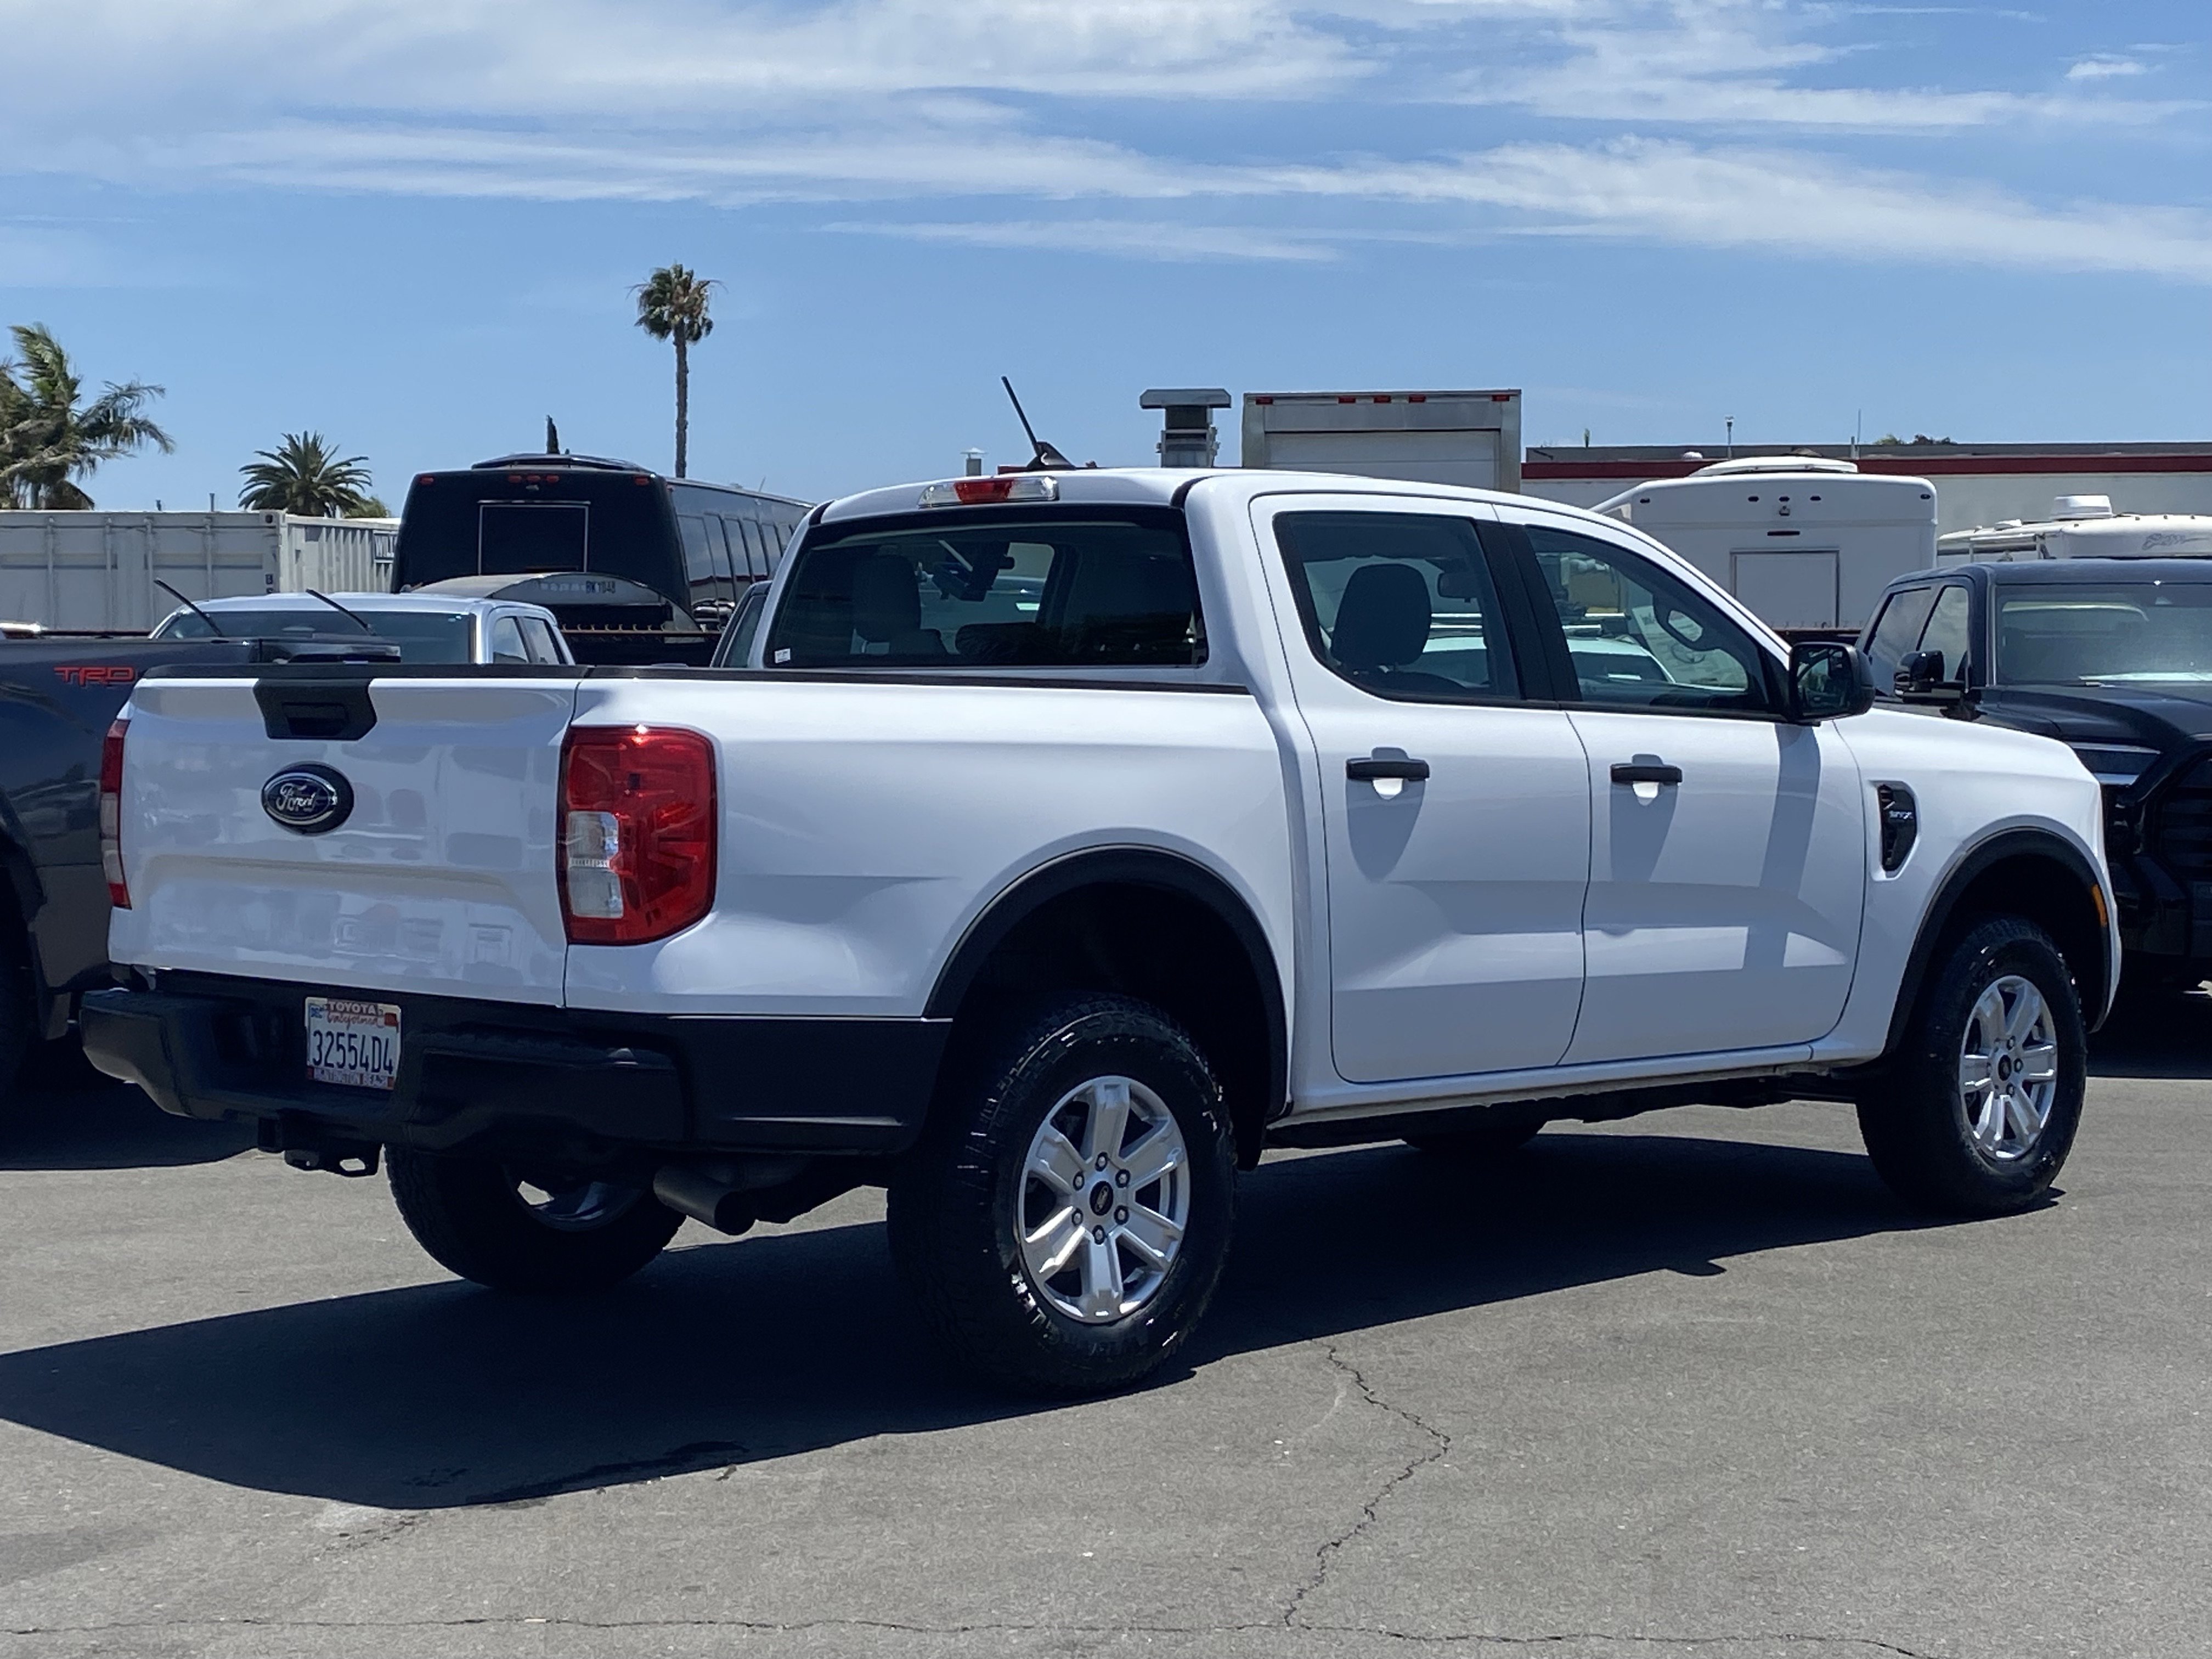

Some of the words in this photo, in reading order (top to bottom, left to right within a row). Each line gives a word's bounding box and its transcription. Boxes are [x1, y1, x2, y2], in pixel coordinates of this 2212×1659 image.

[54, 666, 134, 685] TRD
[276, 783, 317, 812] Ford
[329, 1001, 376, 1014] TOYOTA
[312, 1029, 393, 1075] 32554D4
